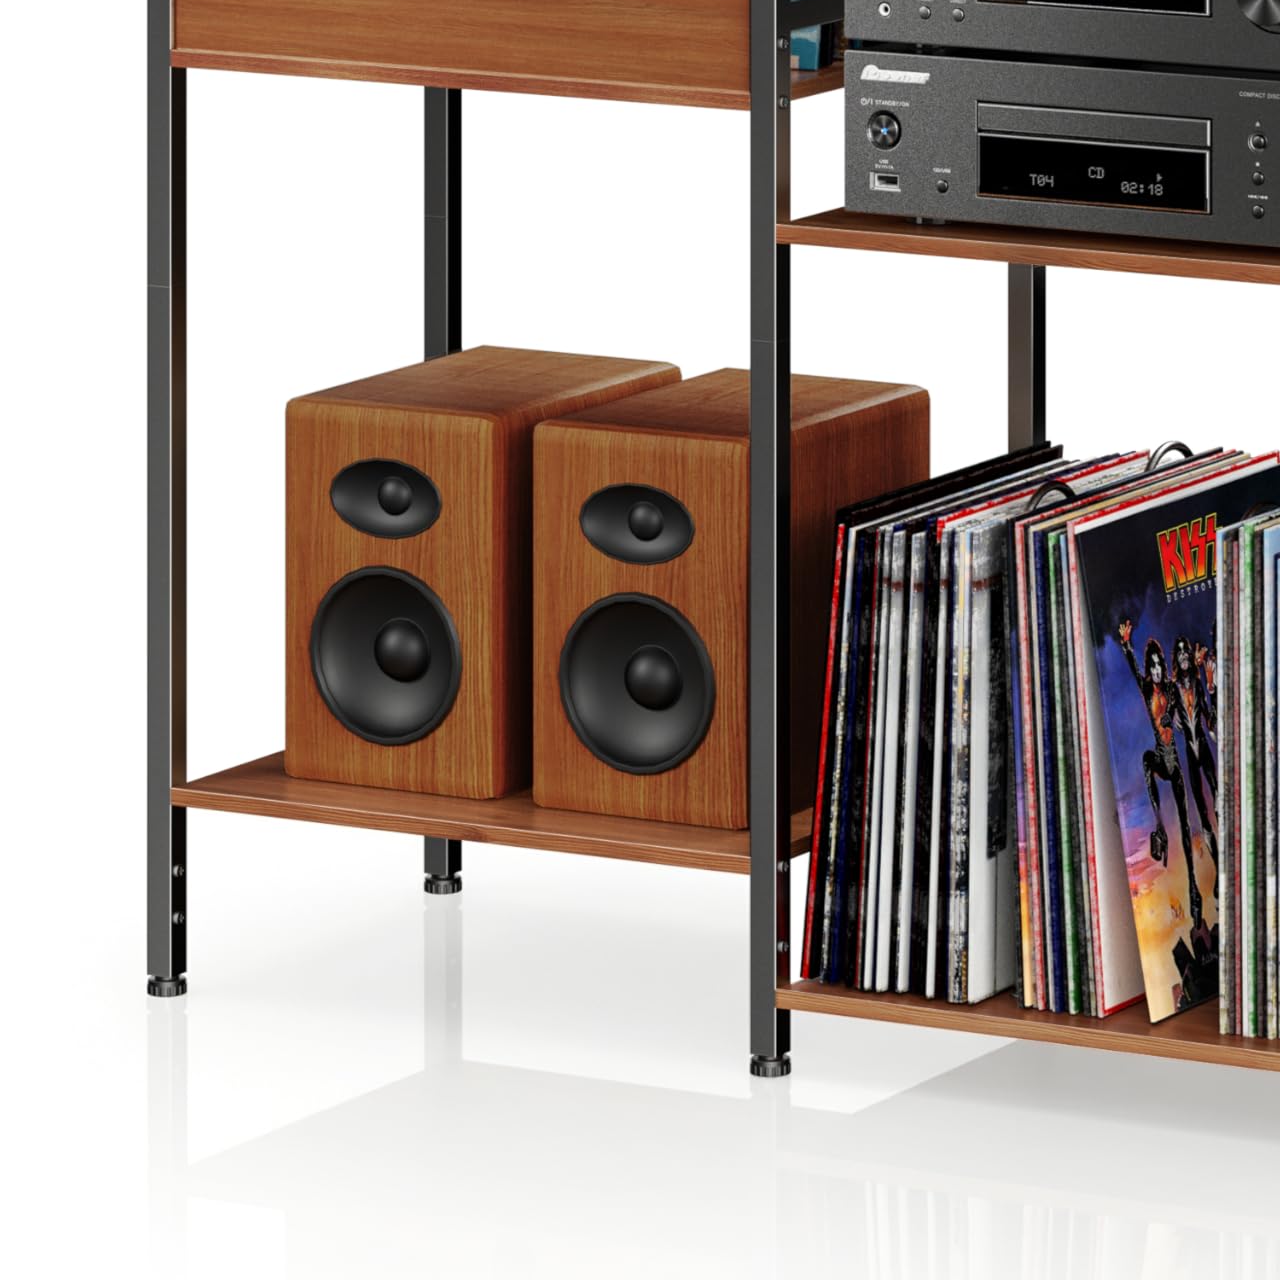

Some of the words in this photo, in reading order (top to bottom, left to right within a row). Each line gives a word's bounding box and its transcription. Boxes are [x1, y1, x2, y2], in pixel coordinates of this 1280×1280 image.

[1239, 91, 1266, 99] COMPACT
[1088, 166, 1105, 179] CD
[1120, 181, 1164, 196] 02:18
[1166, 576, 1217, 604] DESTROY
